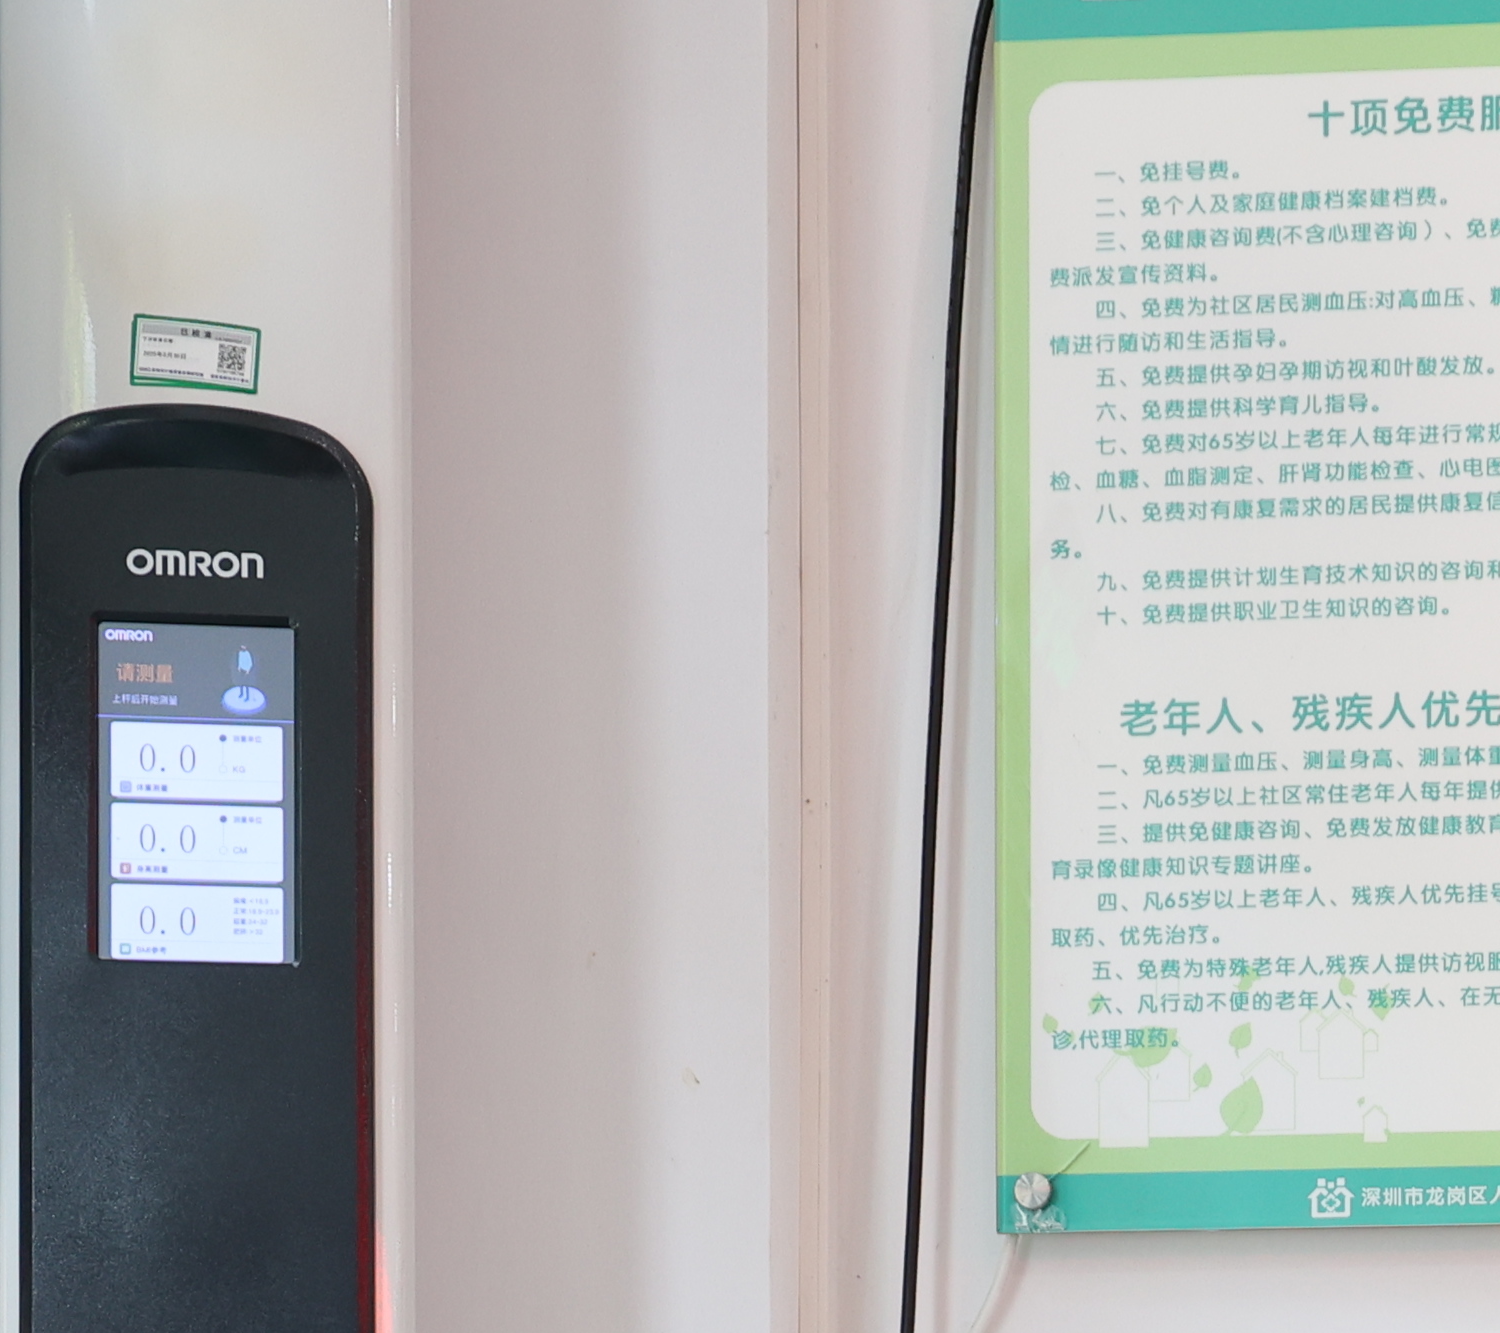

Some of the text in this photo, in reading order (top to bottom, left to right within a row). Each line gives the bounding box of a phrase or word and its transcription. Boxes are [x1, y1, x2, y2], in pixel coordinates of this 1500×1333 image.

[1095, 160, 1244, 186] 一、免挂号费。
[1095, 186, 1450, 219] 二、免个人及家庭健康档案建档费。
[1049, 261, 1221, 288] 费派发宣传资料。
[1049, 327, 1288, 356] 情进行随访和生活指导。
[1095, 354, 1498, 388] 五、免费提供孕妇孕期访视和叶酸发放。
[1095, 392, 1382, 423] 六、免费提供科学育儿指导。
[126, 548, 264, 578] OMRON
[1049, 538, 1084, 562] 务。
[1096, 596, 1451, 629] 十、免费提供职业卫生知识的咨询。
[104, 628, 154, 642] OMRON
[116, 663, 174, 683] 请测量
[139, 743, 196, 773] 0.0
[139, 823, 196, 853] 0.0
[1050, 852, 1314, 882] 育录像健康知识专题讲座。
[139, 905, 196, 936] 0.0
[1050, 923, 1222, 949] 取药、优先治疗。
